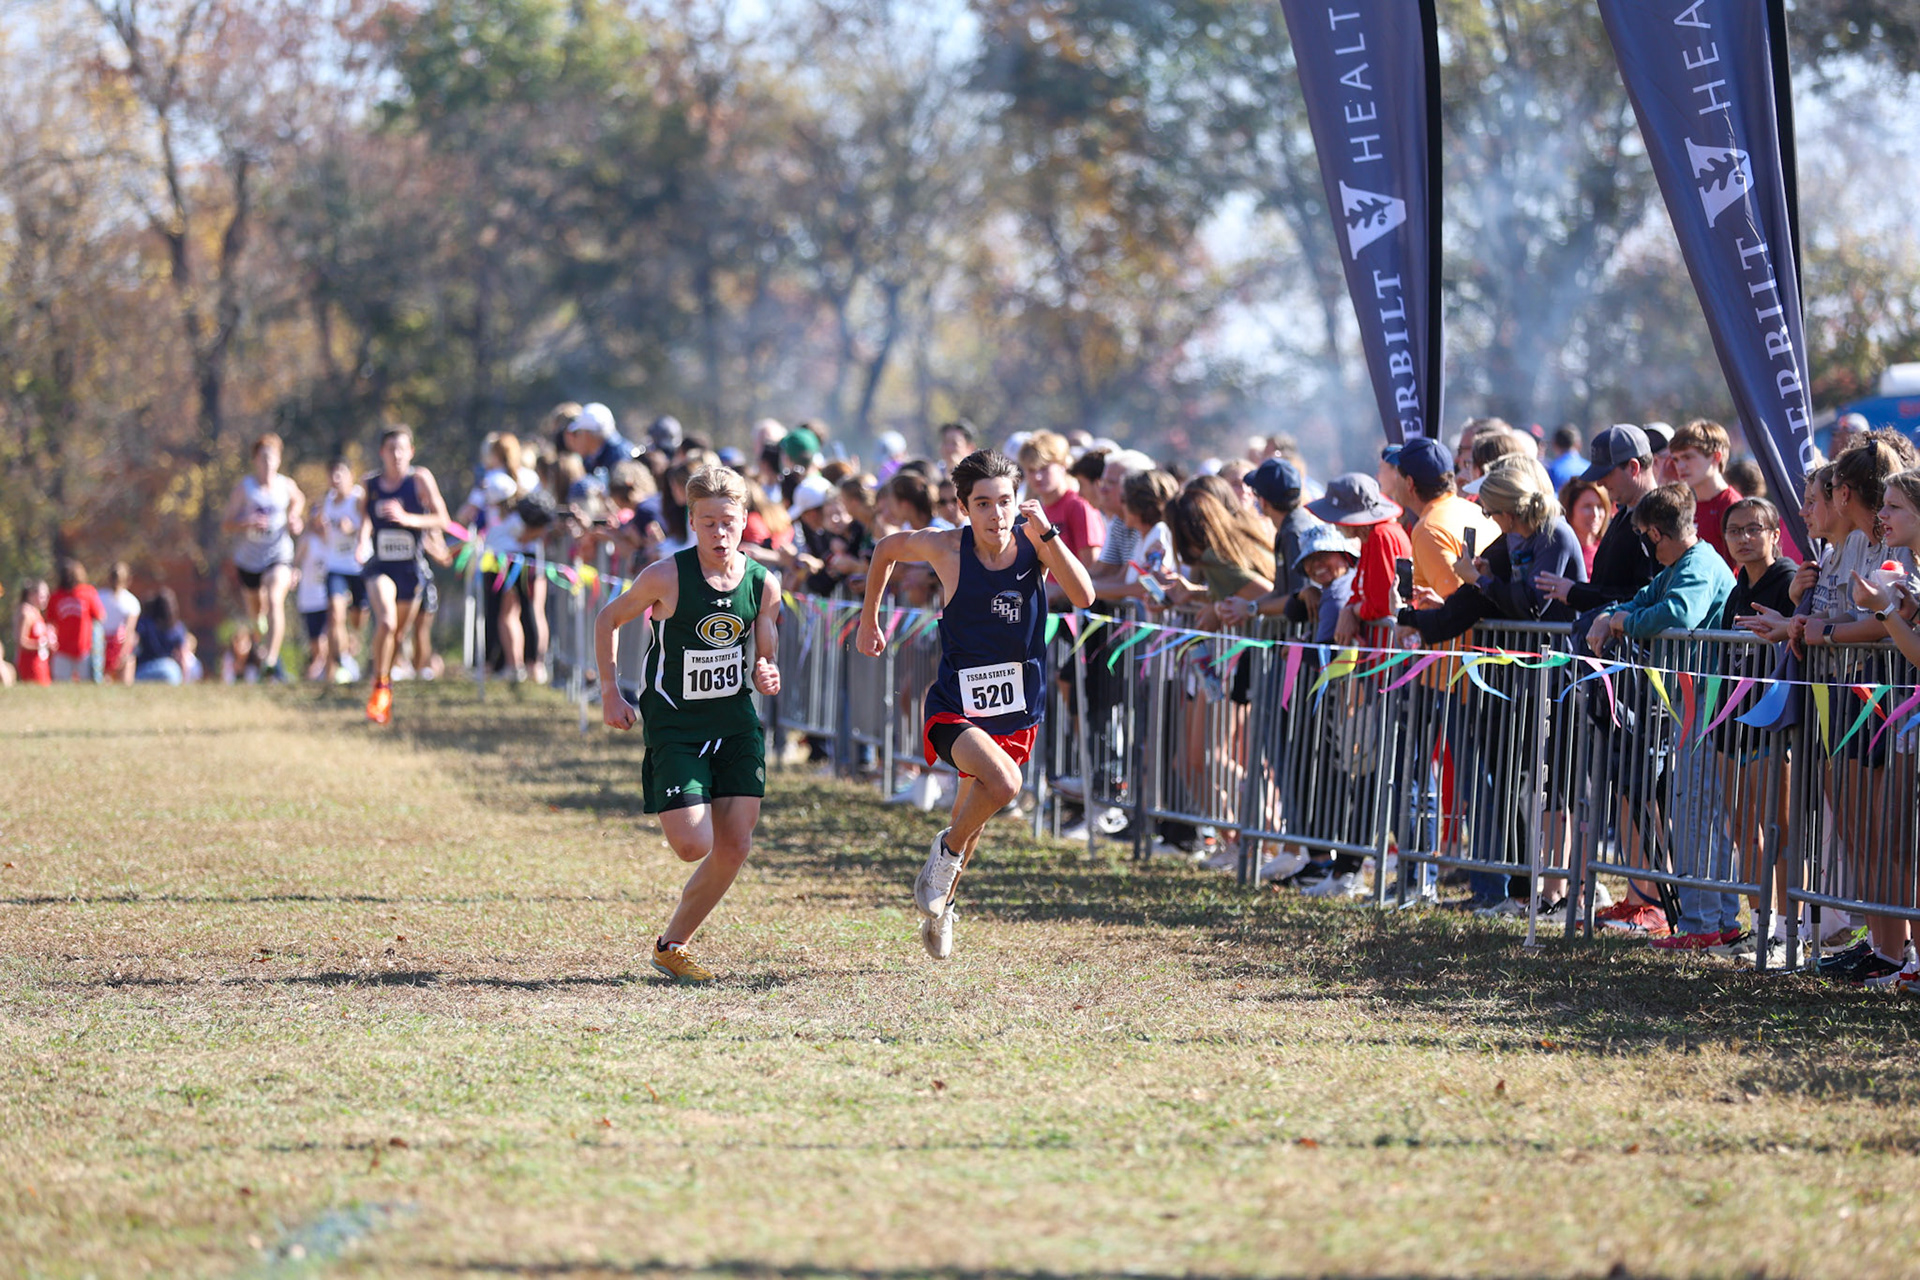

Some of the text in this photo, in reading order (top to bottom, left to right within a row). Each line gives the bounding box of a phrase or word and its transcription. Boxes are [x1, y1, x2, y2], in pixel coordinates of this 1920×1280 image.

[991, 597, 1020, 623] SBA
[691, 651, 738, 664] TMSAA STATE XC
[688, 664, 738, 692] 1039
[966, 667, 1016, 682] TSSAA STATE XC
[971, 681, 1015, 711] 520
